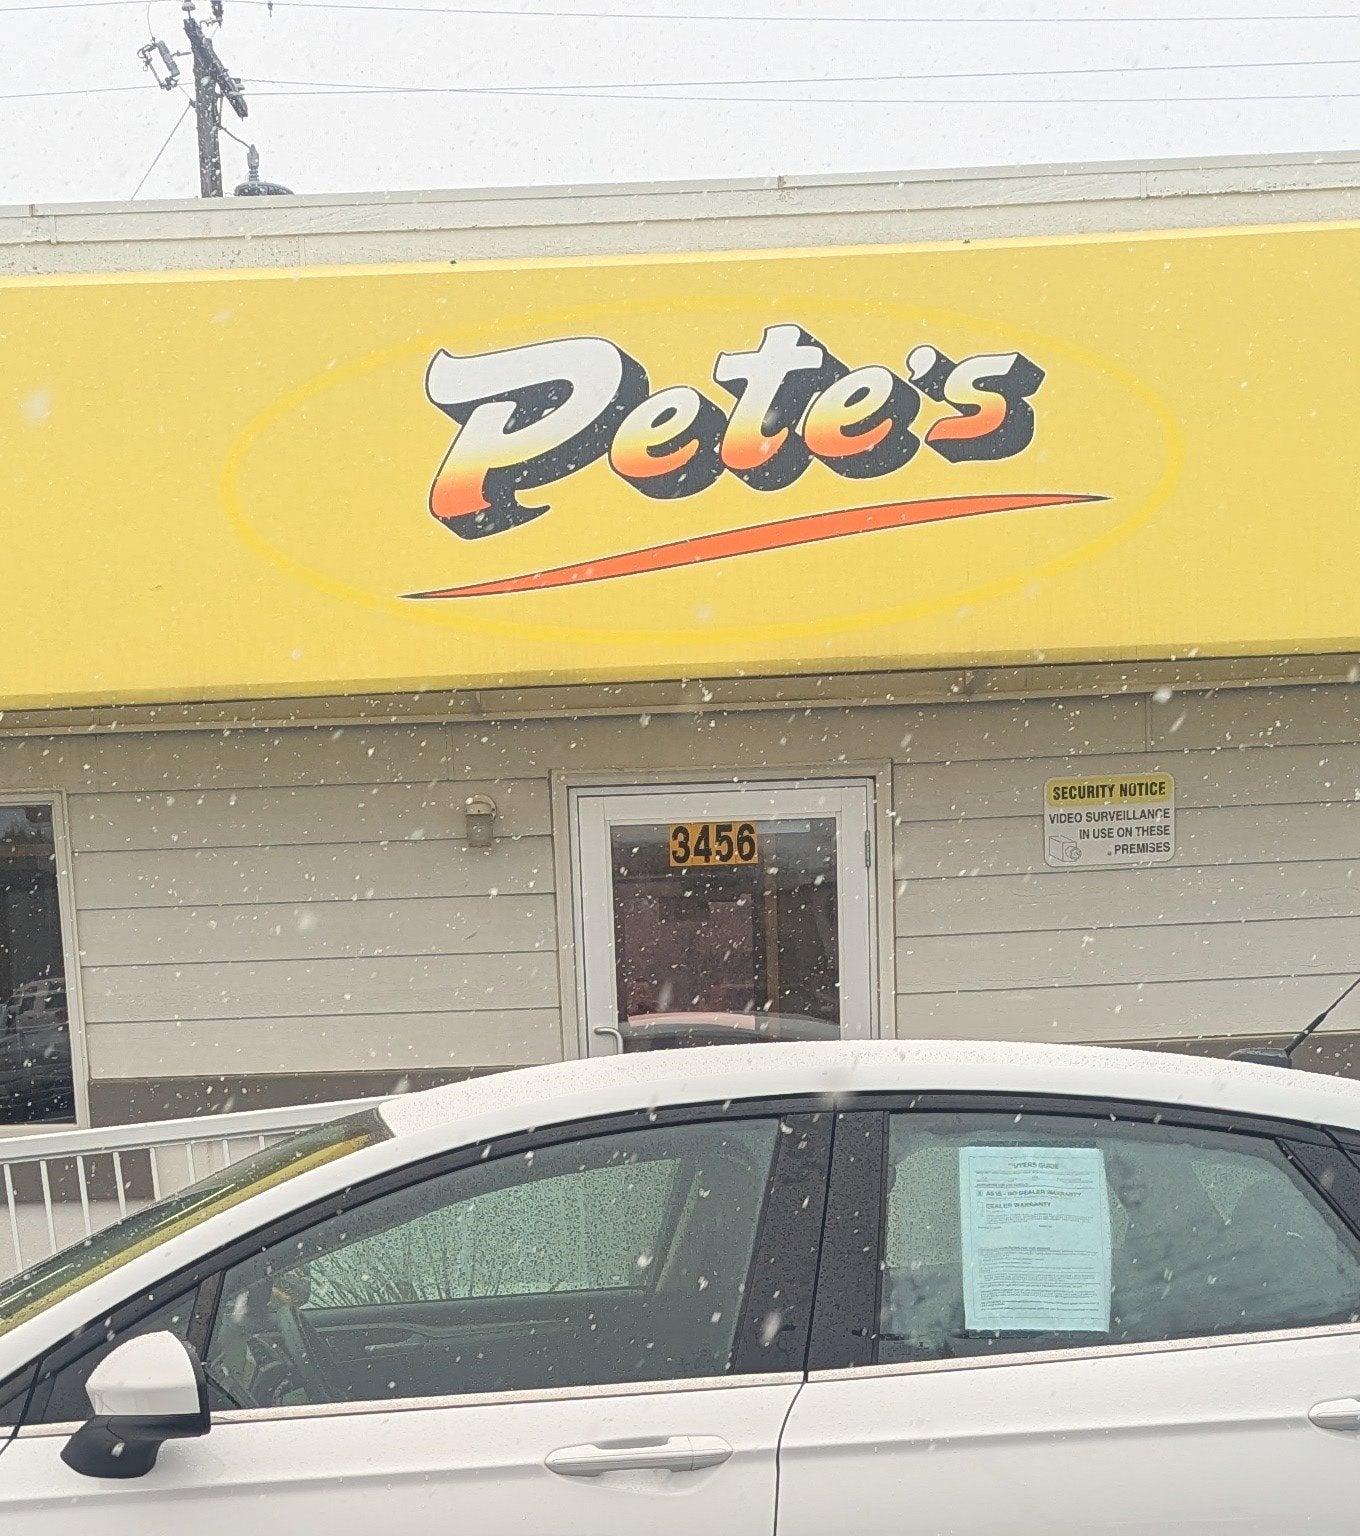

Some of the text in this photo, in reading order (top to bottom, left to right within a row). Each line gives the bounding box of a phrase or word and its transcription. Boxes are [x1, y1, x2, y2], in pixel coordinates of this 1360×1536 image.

[425, 323, 1047, 541] Pete's
[1052, 781, 1166, 801] SECURITY NOTICE
[1049, 808, 1171, 825] VIDEO SURVEILLANCE
[1079, 824, 1171, 840] IN USE ON THESE
[670, 822, 757, 864] 3456
[1114, 841, 1171, 855] PREMISES
